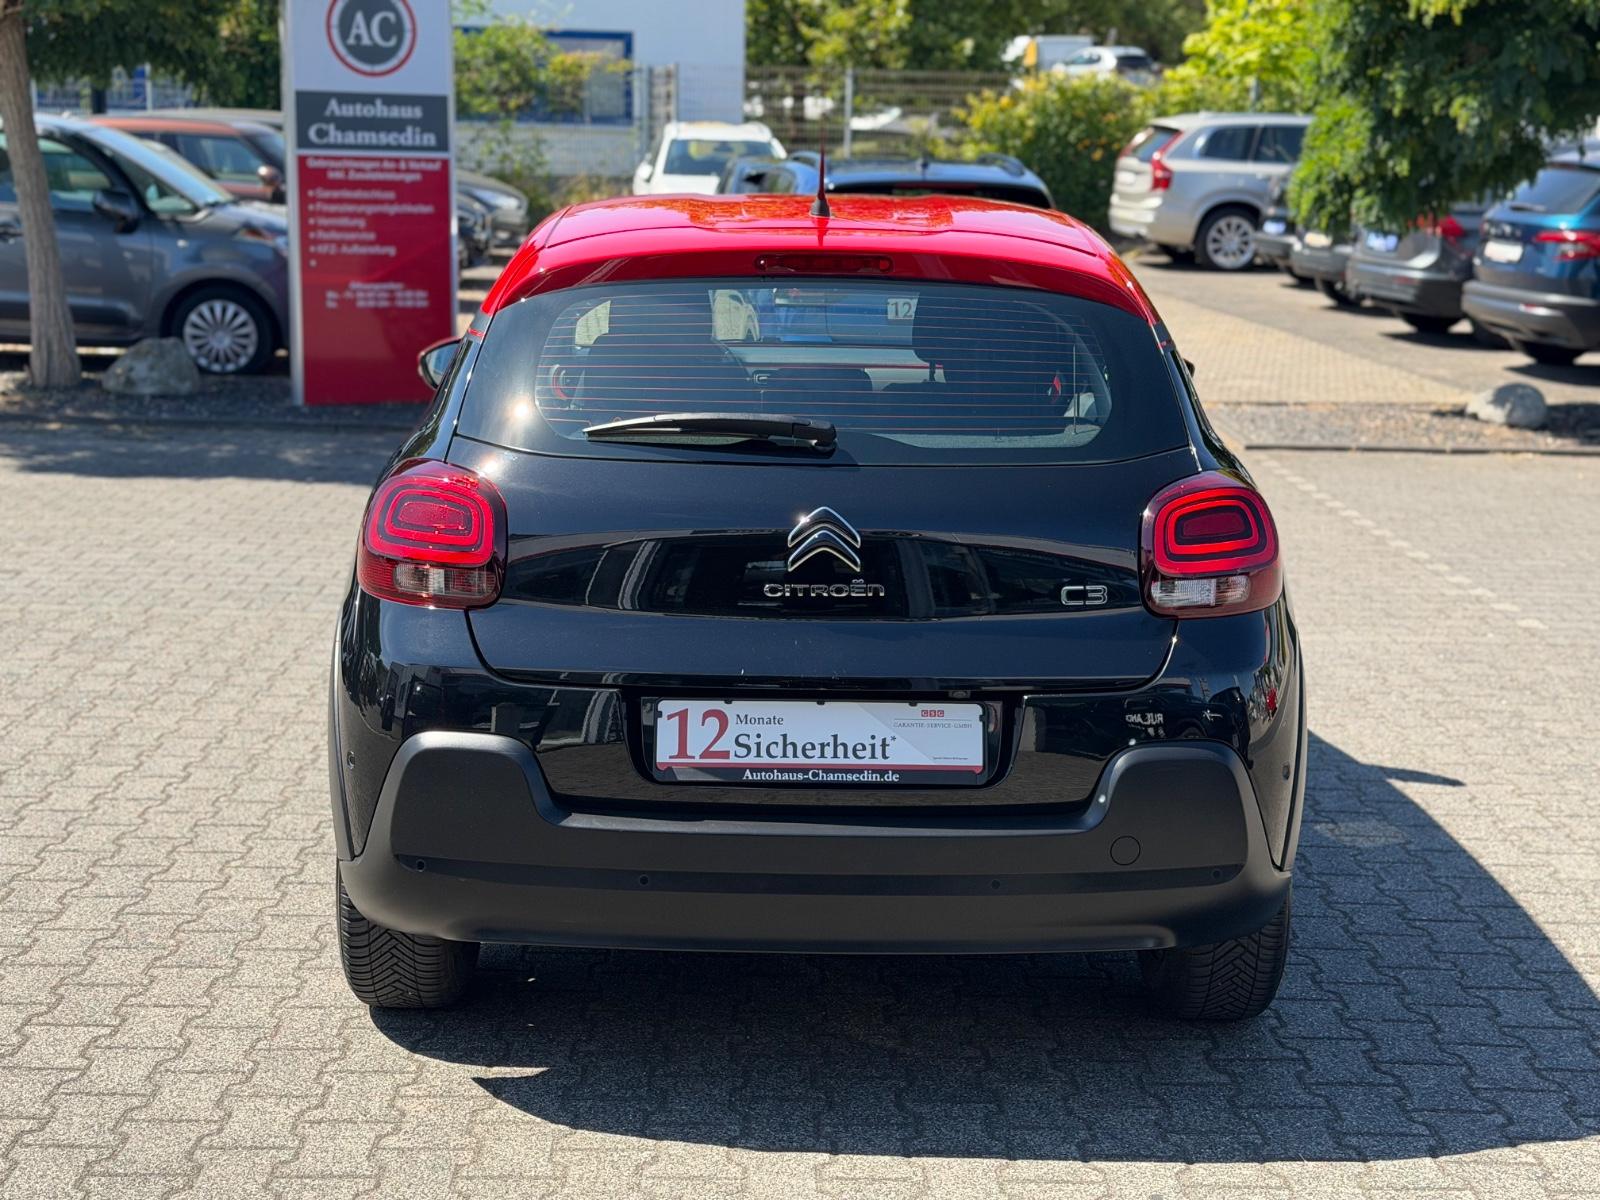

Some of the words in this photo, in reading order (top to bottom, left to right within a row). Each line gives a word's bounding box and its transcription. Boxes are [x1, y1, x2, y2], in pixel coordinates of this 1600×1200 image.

[346, 11, 398, 47] AC
[324, 98, 423, 119] Autohaus
[308, 123, 437, 146] Chamsedin
[890, 301, 912, 318] 12
[763, 578, 885, 598] CITROËN
[1060, 584, 1108, 606] C3
[735, 714, 784, 726] Monate
[666, 707, 731, 760] 12
[742, 769, 900, 783] Autohaus-Chamsedin.de
